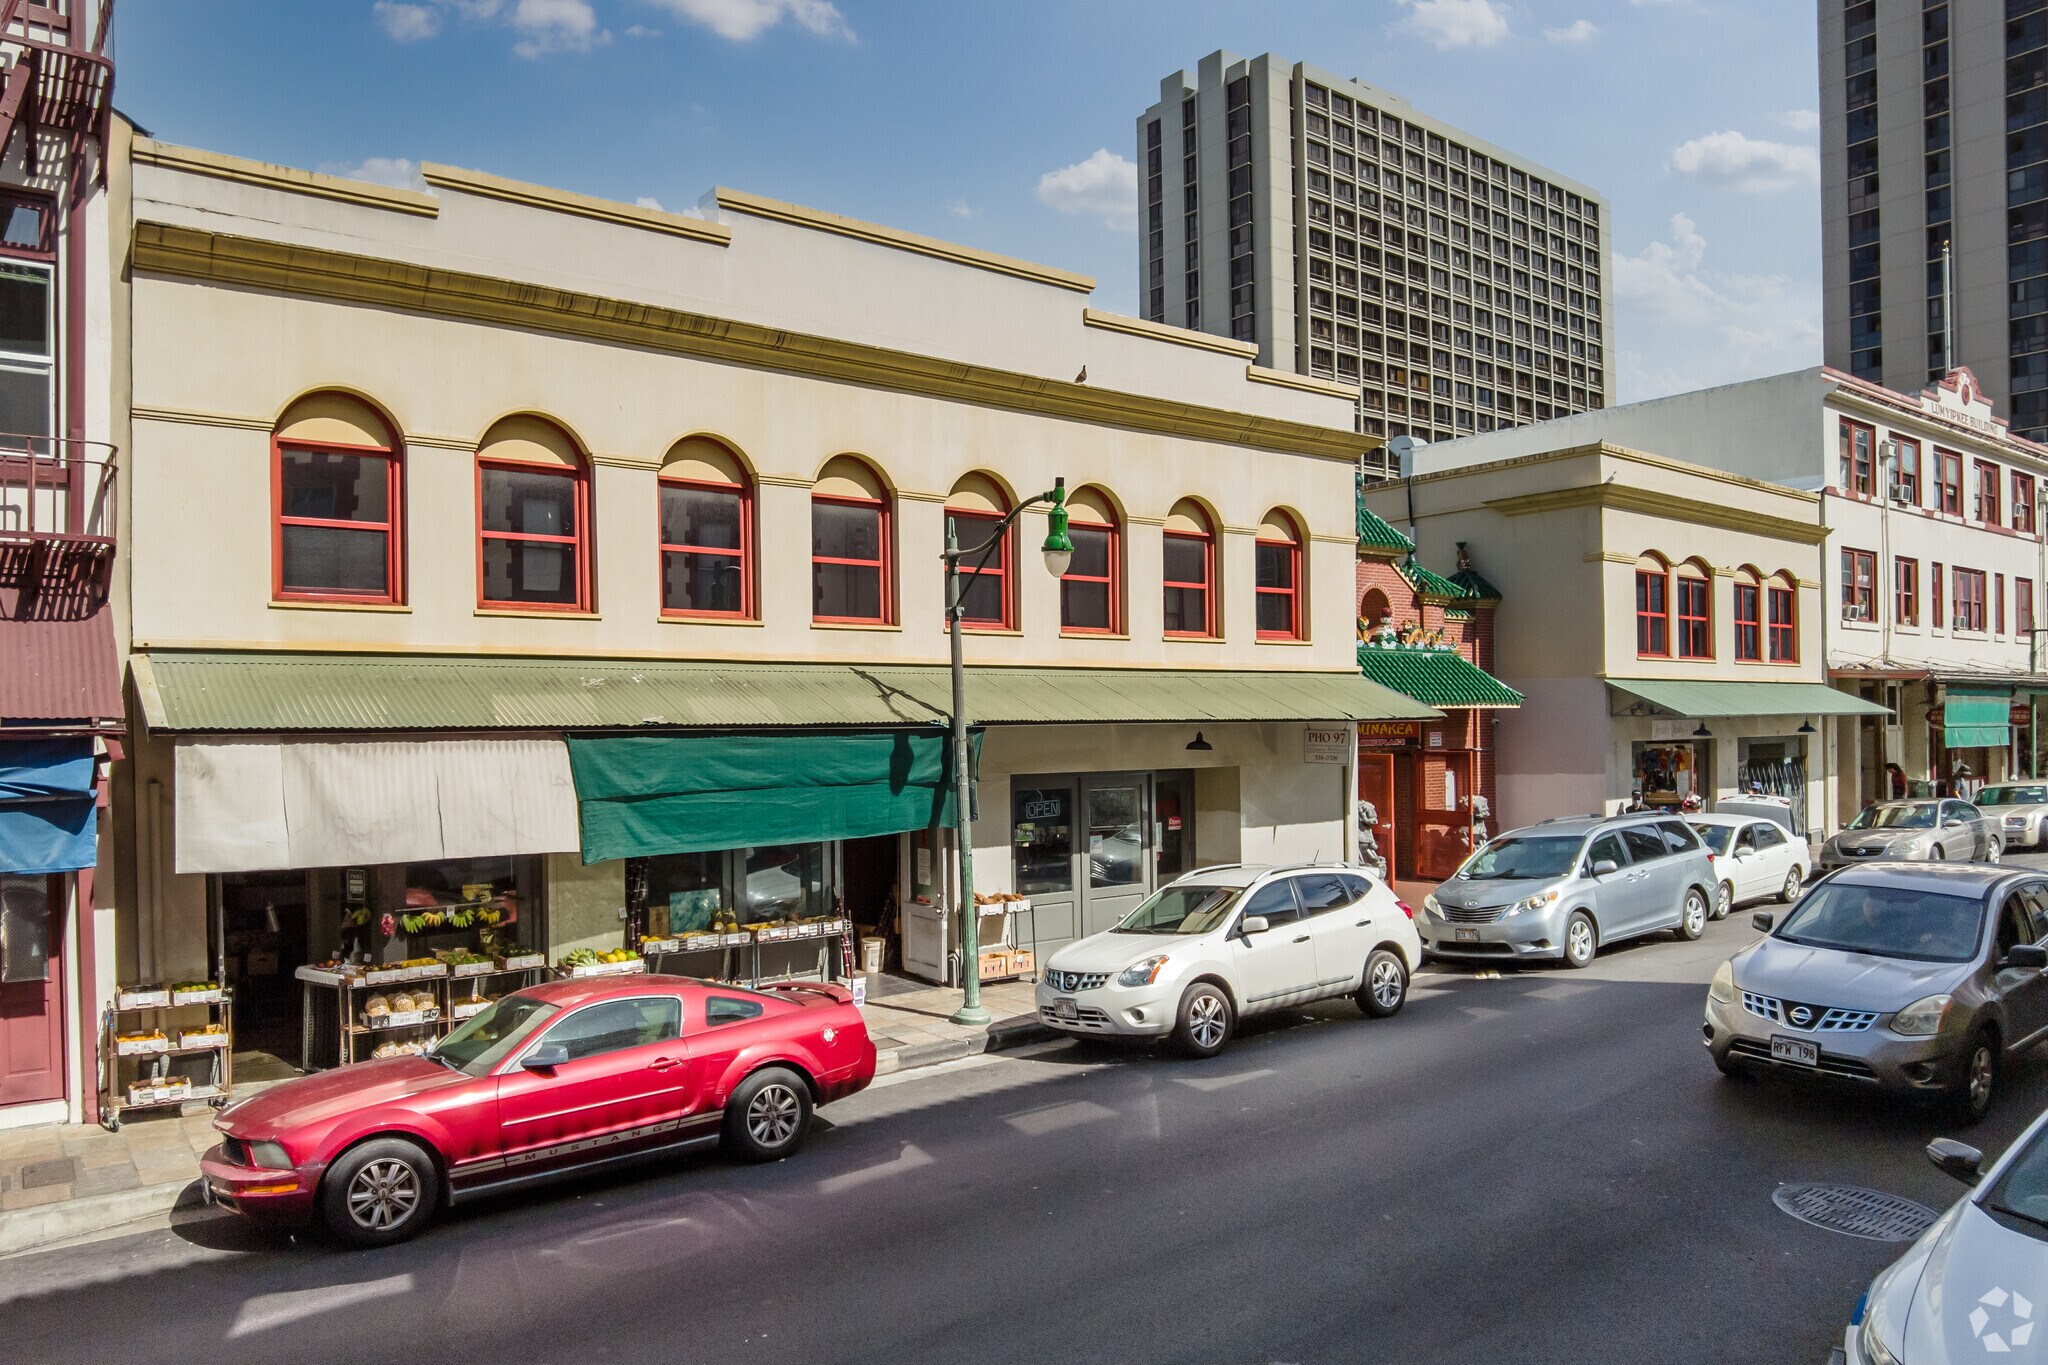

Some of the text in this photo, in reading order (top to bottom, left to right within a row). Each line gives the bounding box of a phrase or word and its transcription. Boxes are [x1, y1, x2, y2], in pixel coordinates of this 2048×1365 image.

[1931, 402, 1945, 417] LUM
[1970, 416, 1998, 435] BUILDING
[1357, 723, 1413, 735] UNAKEA
[1308, 732, 1346, 744] PHO 97
[1028, 802, 1059, 817] OPEN
[1798, 1046, 1815, 1060] 198
[525, 1125, 662, 1161] MUSTANG
